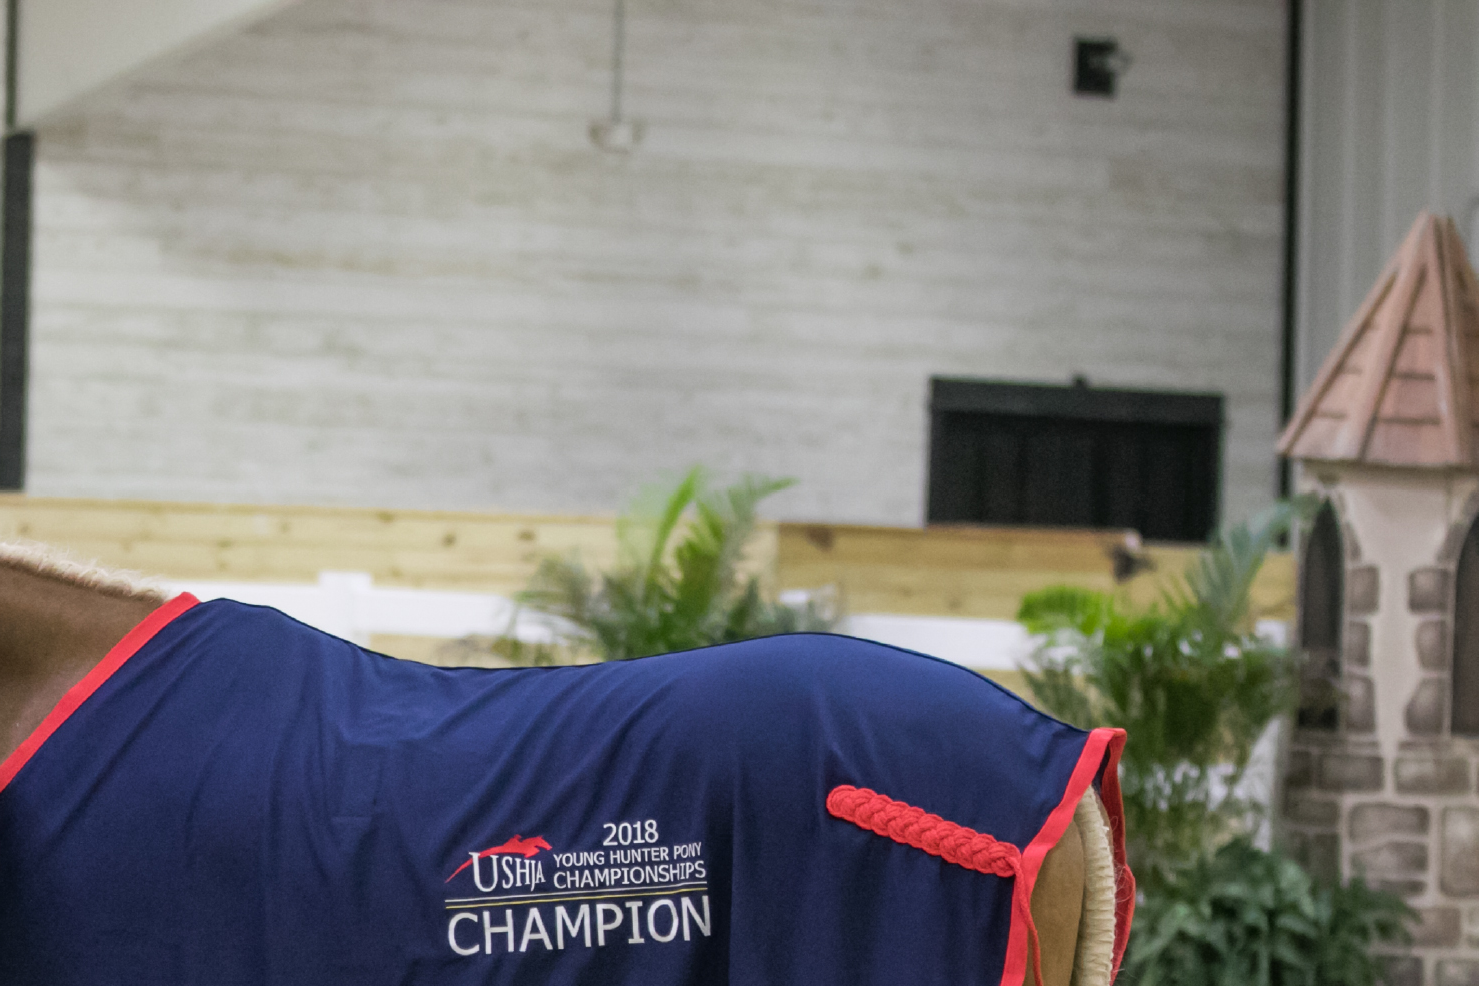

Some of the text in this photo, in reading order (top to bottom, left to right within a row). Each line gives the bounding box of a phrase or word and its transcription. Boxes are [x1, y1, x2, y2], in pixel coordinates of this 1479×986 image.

[603, 819, 659, 846] 2018
[553, 842, 702, 868] YOUNG HUNTER PONY
[468, 852, 546, 892] USHJA
[553, 861, 706, 890] CHAMPIONSHIPS
[447, 895, 711, 956] CHAMPION
